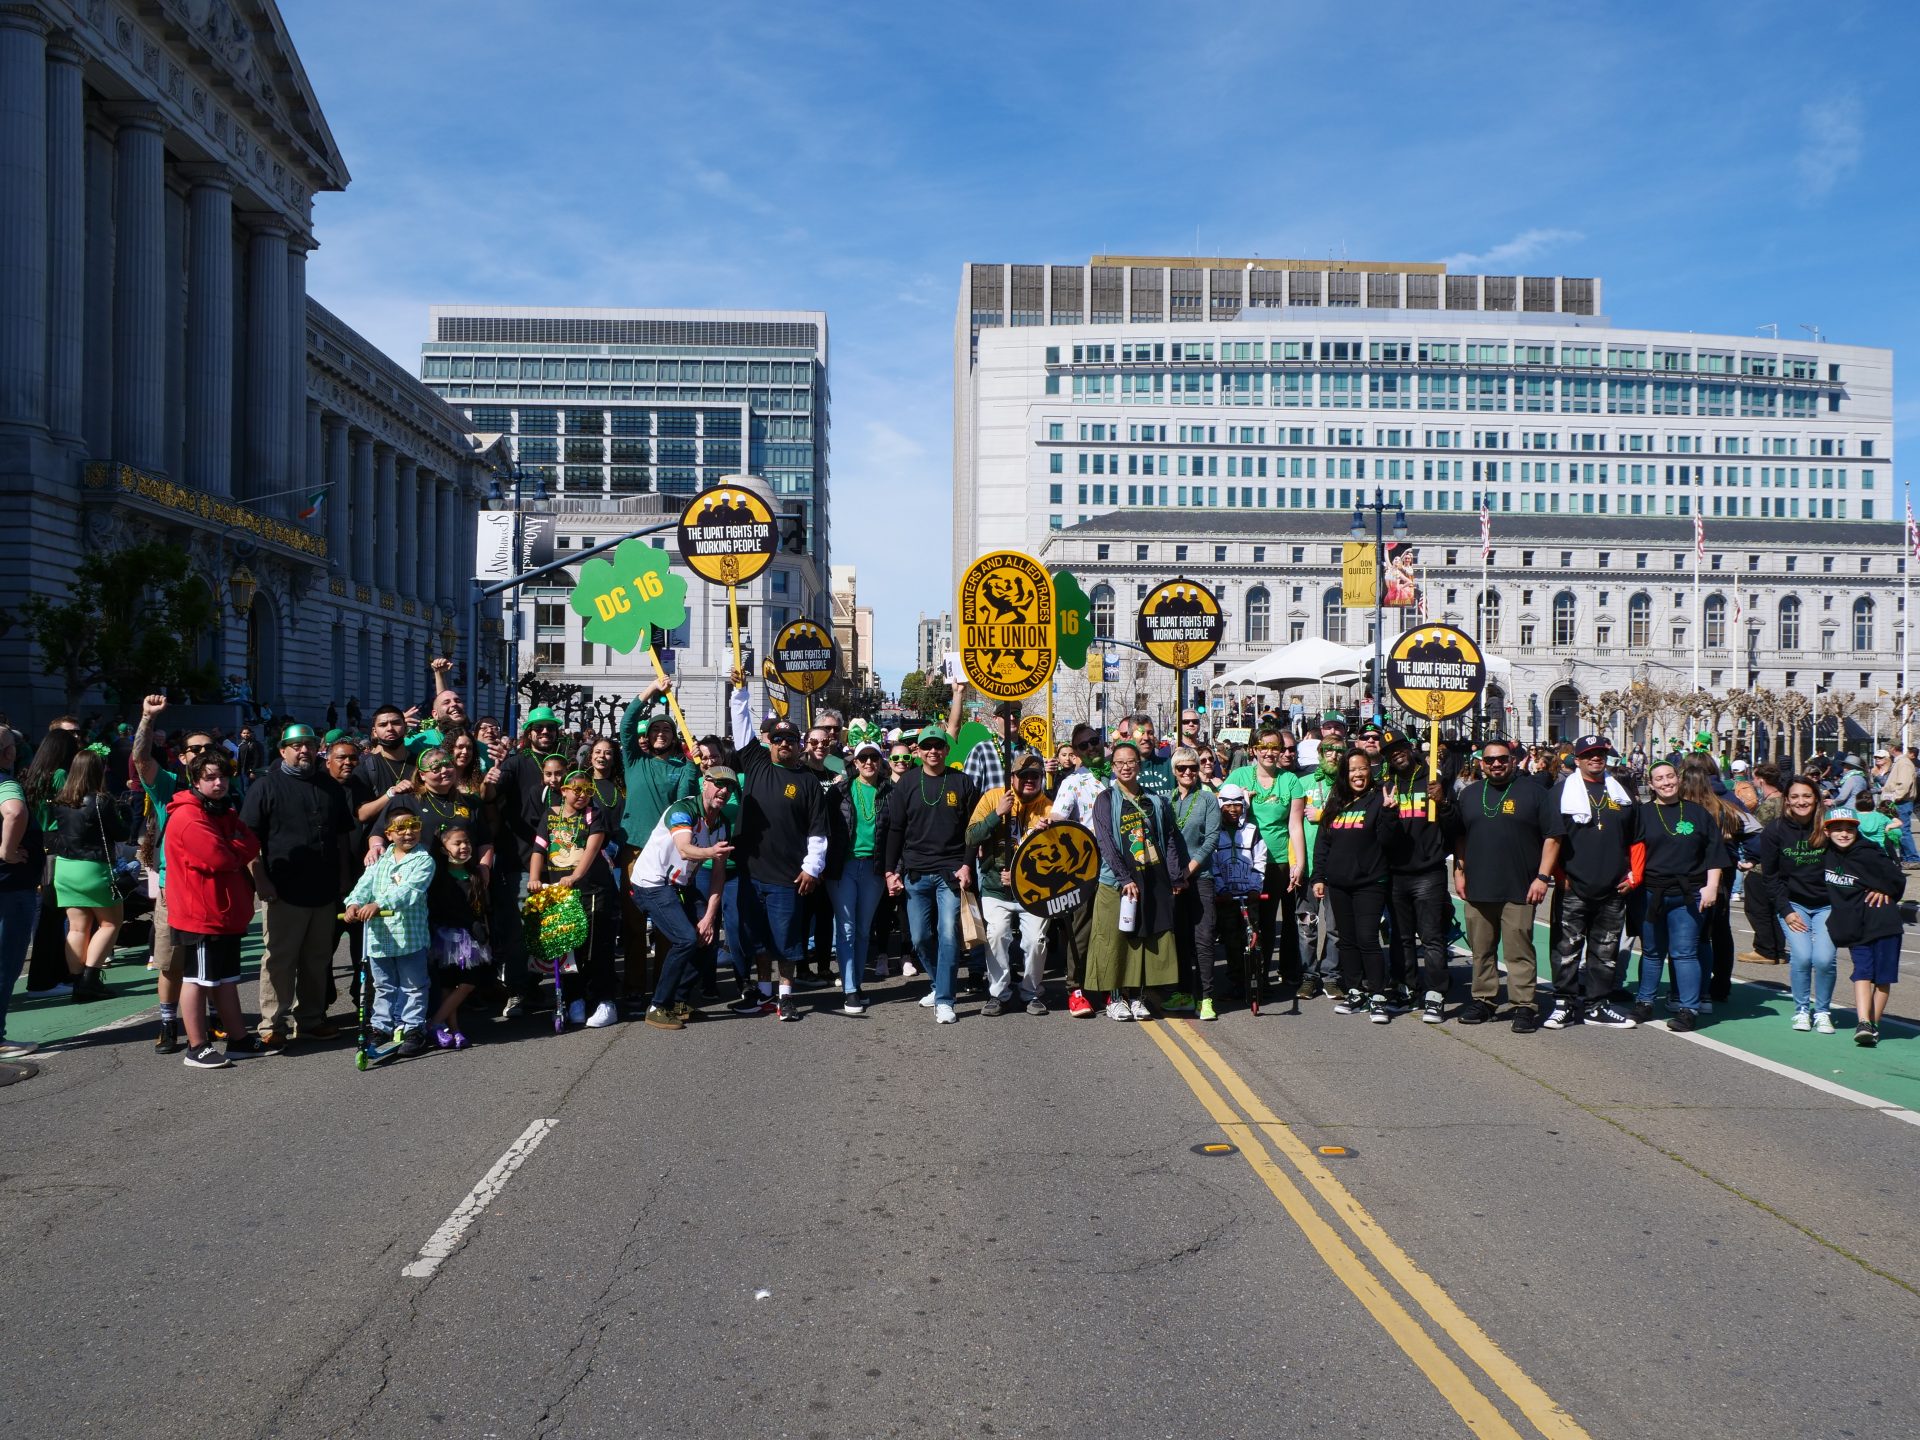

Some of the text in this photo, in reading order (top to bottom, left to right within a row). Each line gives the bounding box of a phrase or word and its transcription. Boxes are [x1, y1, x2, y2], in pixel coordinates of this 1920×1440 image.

[687, 524, 769, 540] THE IUPAT FIGHTS FOR
[696, 539, 762, 554] WORKING PEOPLE
[594, 570, 664, 622] DC 16
[964, 556, 1050, 622] PAINTERS AND ALLIED TRADES
[1059, 609, 1079, 635] 16
[1146, 615, 1215, 628] THE IUPAT FIGHTS FOR
[967, 625, 1047, 648] ONE UNION
[1152, 628, 1209, 640] WORKING PEOPLE
[780, 651, 789, 660] THE
[804, 649, 821, 660] FIGHTS
[821, 649, 831, 659] FOR
[785, 660, 827, 671] WORKING PEOPLE
[965, 651, 1032, 695] INTERNATIONAL
[1028, 651, 1050, 684] UNION
[1396, 660, 1477, 677] THE IUPAT FIGHTS FOR
[1191, 677, 1202, 685] 20
[1403, 675, 1468, 690] WORKING PEOPLE
[1330, 810, 1367, 829] OVE
[1830, 808, 1853, 819] IRISH
[1824, 871, 1855, 886] OOLIGAN
[1046, 887, 1081, 916] IUPAT
